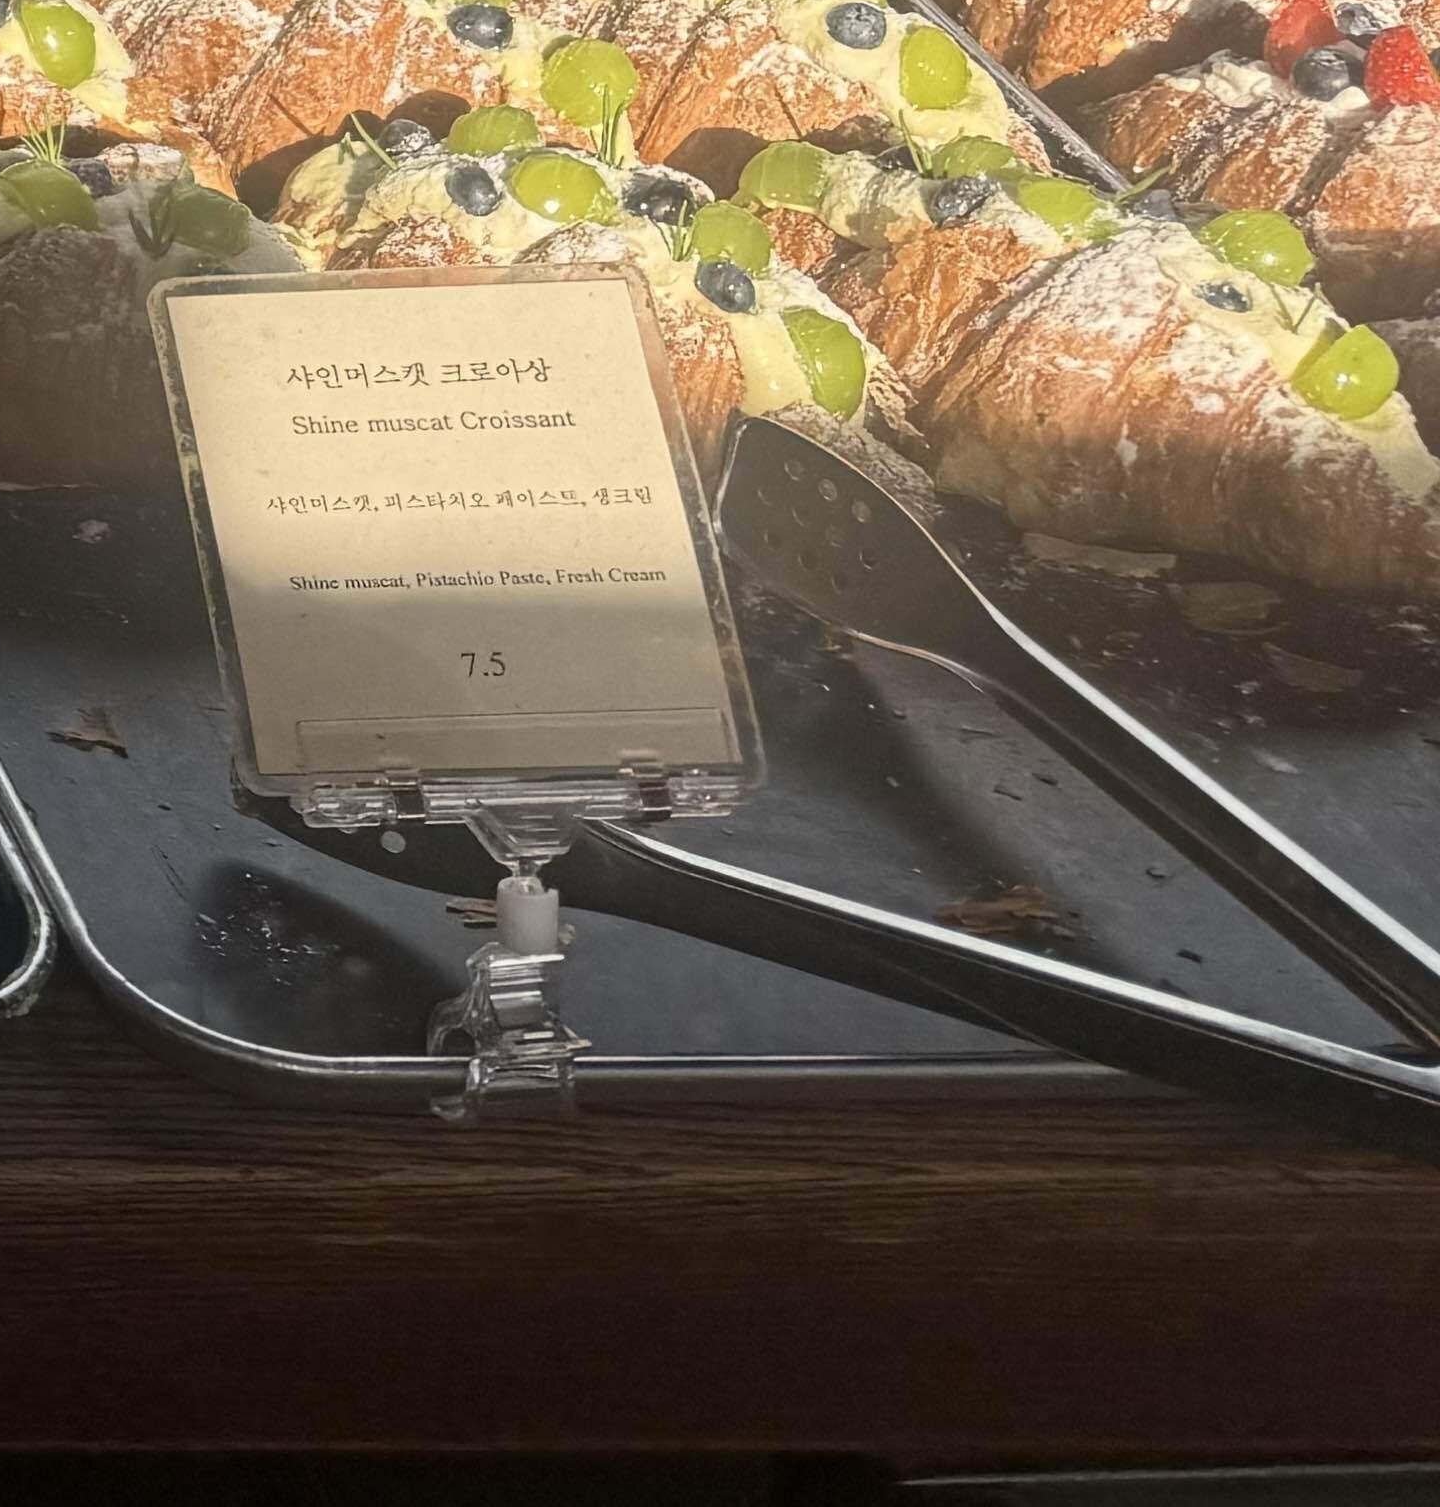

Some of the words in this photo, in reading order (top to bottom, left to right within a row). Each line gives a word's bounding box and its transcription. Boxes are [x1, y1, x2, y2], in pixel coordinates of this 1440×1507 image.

[439, 357, 553, 384] 크로아상
[291, 415, 359, 435] Shine
[367, 414, 454, 433] muscat
[460, 409, 577, 430] Croissant
[384, 491, 491, 512] 피스타치오
[495, 488, 587, 509] 페이스트,
[593, 485, 652, 506] 생크림
[289, 575, 340, 592] Shine
[344, 574, 411, 589] muscat,
[415, 570, 495, 588] Pistachio
[498, 570, 552, 586] Paste,
[555, 567, 605, 584] Fresh
[607, 567, 667, 583] Cream
[460, 651, 506, 678] 7.5
